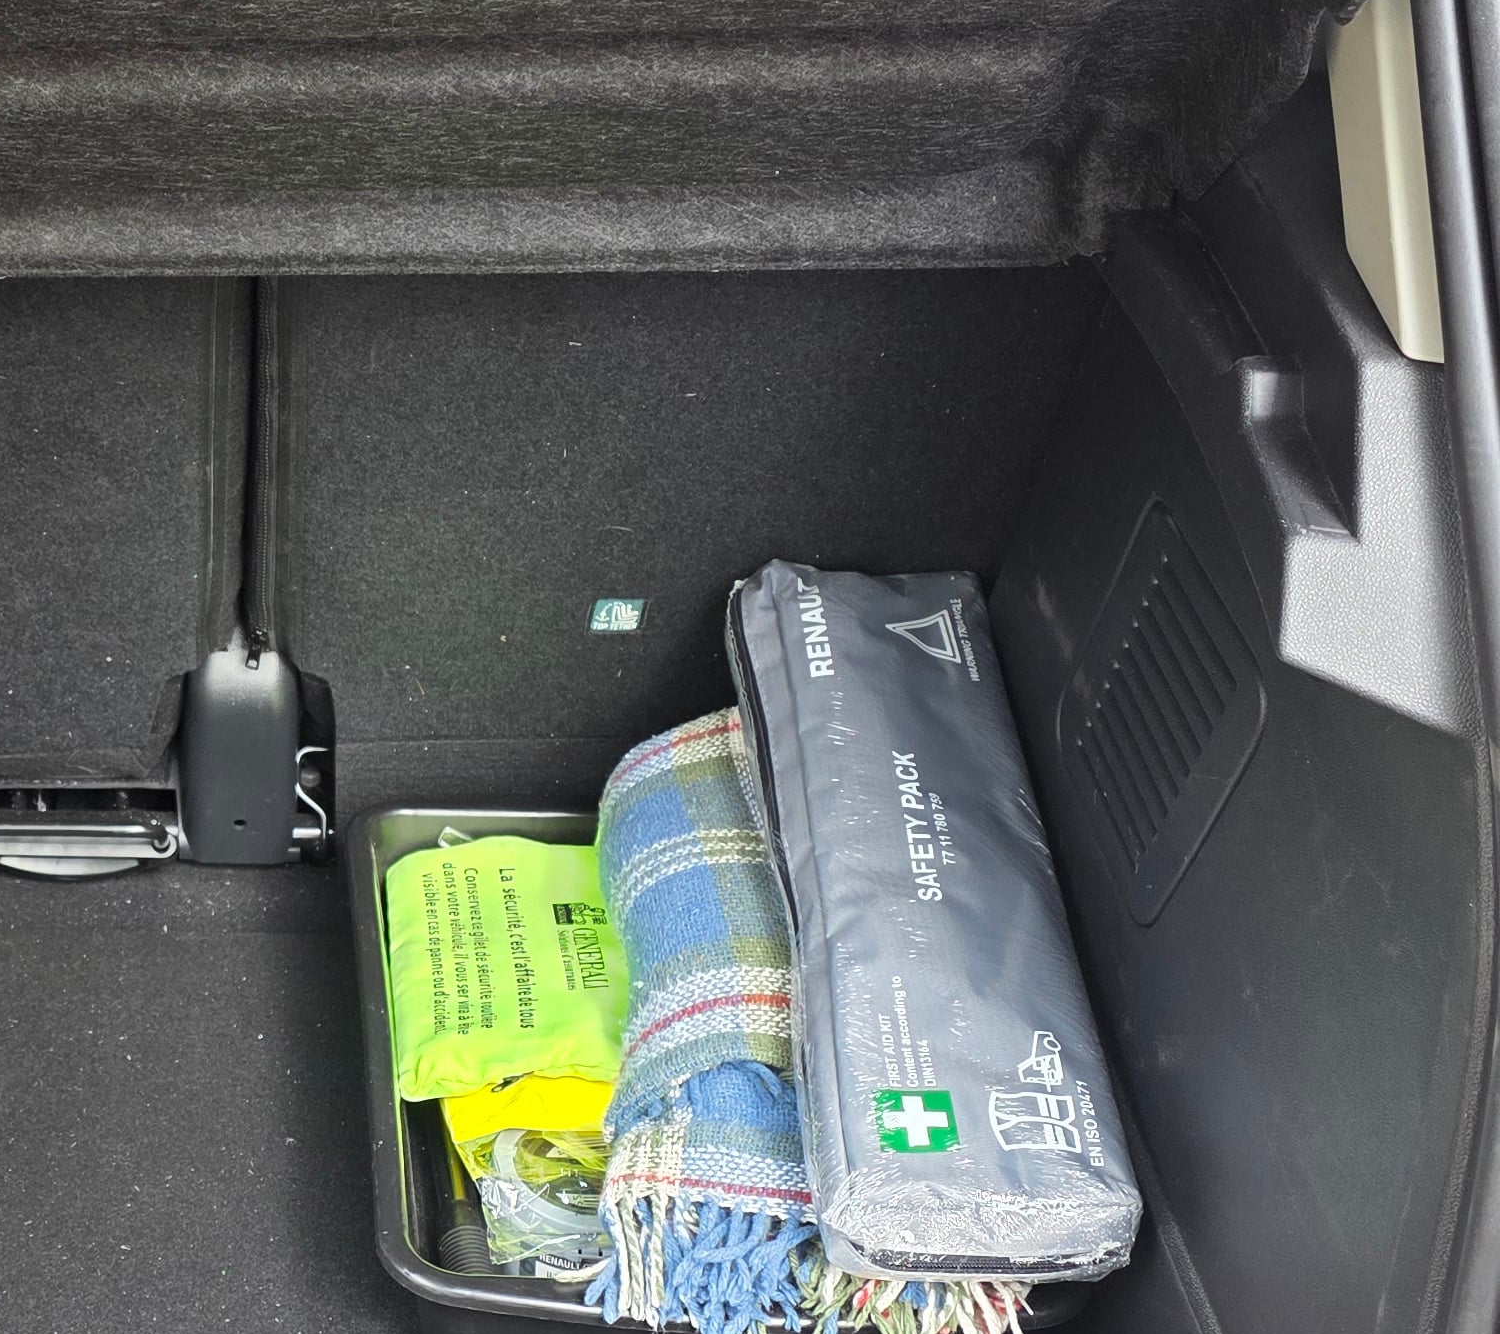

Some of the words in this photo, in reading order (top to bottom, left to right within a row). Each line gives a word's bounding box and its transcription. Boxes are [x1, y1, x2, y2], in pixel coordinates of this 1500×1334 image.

[950, 598, 970, 638] TRIANGLE
[961, 639, 980, 682] WARNING
[892, 750, 925, 810] PACK
[933, 813, 949, 832] 780
[938, 835, 953, 846] 11
[903, 813, 943, 901] SAFETY
[942, 850, 956, 866] 77
[442, 862, 457, 889] dans
[498, 868, 515, 882] La
[422, 872, 440, 907] visible
[463, 867, 481, 921] Conservez
[426, 909, 438, 919] en
[446, 891, 460, 916] votre
[428, 921, 440, 935] cas
[428, 937, 445, 946] de
[468, 931, 489, 950] gilet
[426, 948, 443, 975] panne
[475, 951, 491, 962] de
[572, 928, 609, 989] GENERALI
[433, 977, 445, 988] ou
[454, 961, 468, 982] vous
[476, 964, 496, 1000] sécurité
[891, 975, 902, 988] to
[518, 997, 538, 1007] de
[519, 1008, 536, 1028] tous
[878, 1013, 892, 1033] KIT
[893, 990, 911, 1046] according
[882, 1034, 895, 1056] AID
[884, 1057, 902, 1088] FIRST
[904, 1048, 919, 1088] Content
[1075, 1080, 1095, 1117] 20471
[1083, 1118, 1100, 1144] ISO
[1088, 1146, 1104, 1167] EN
